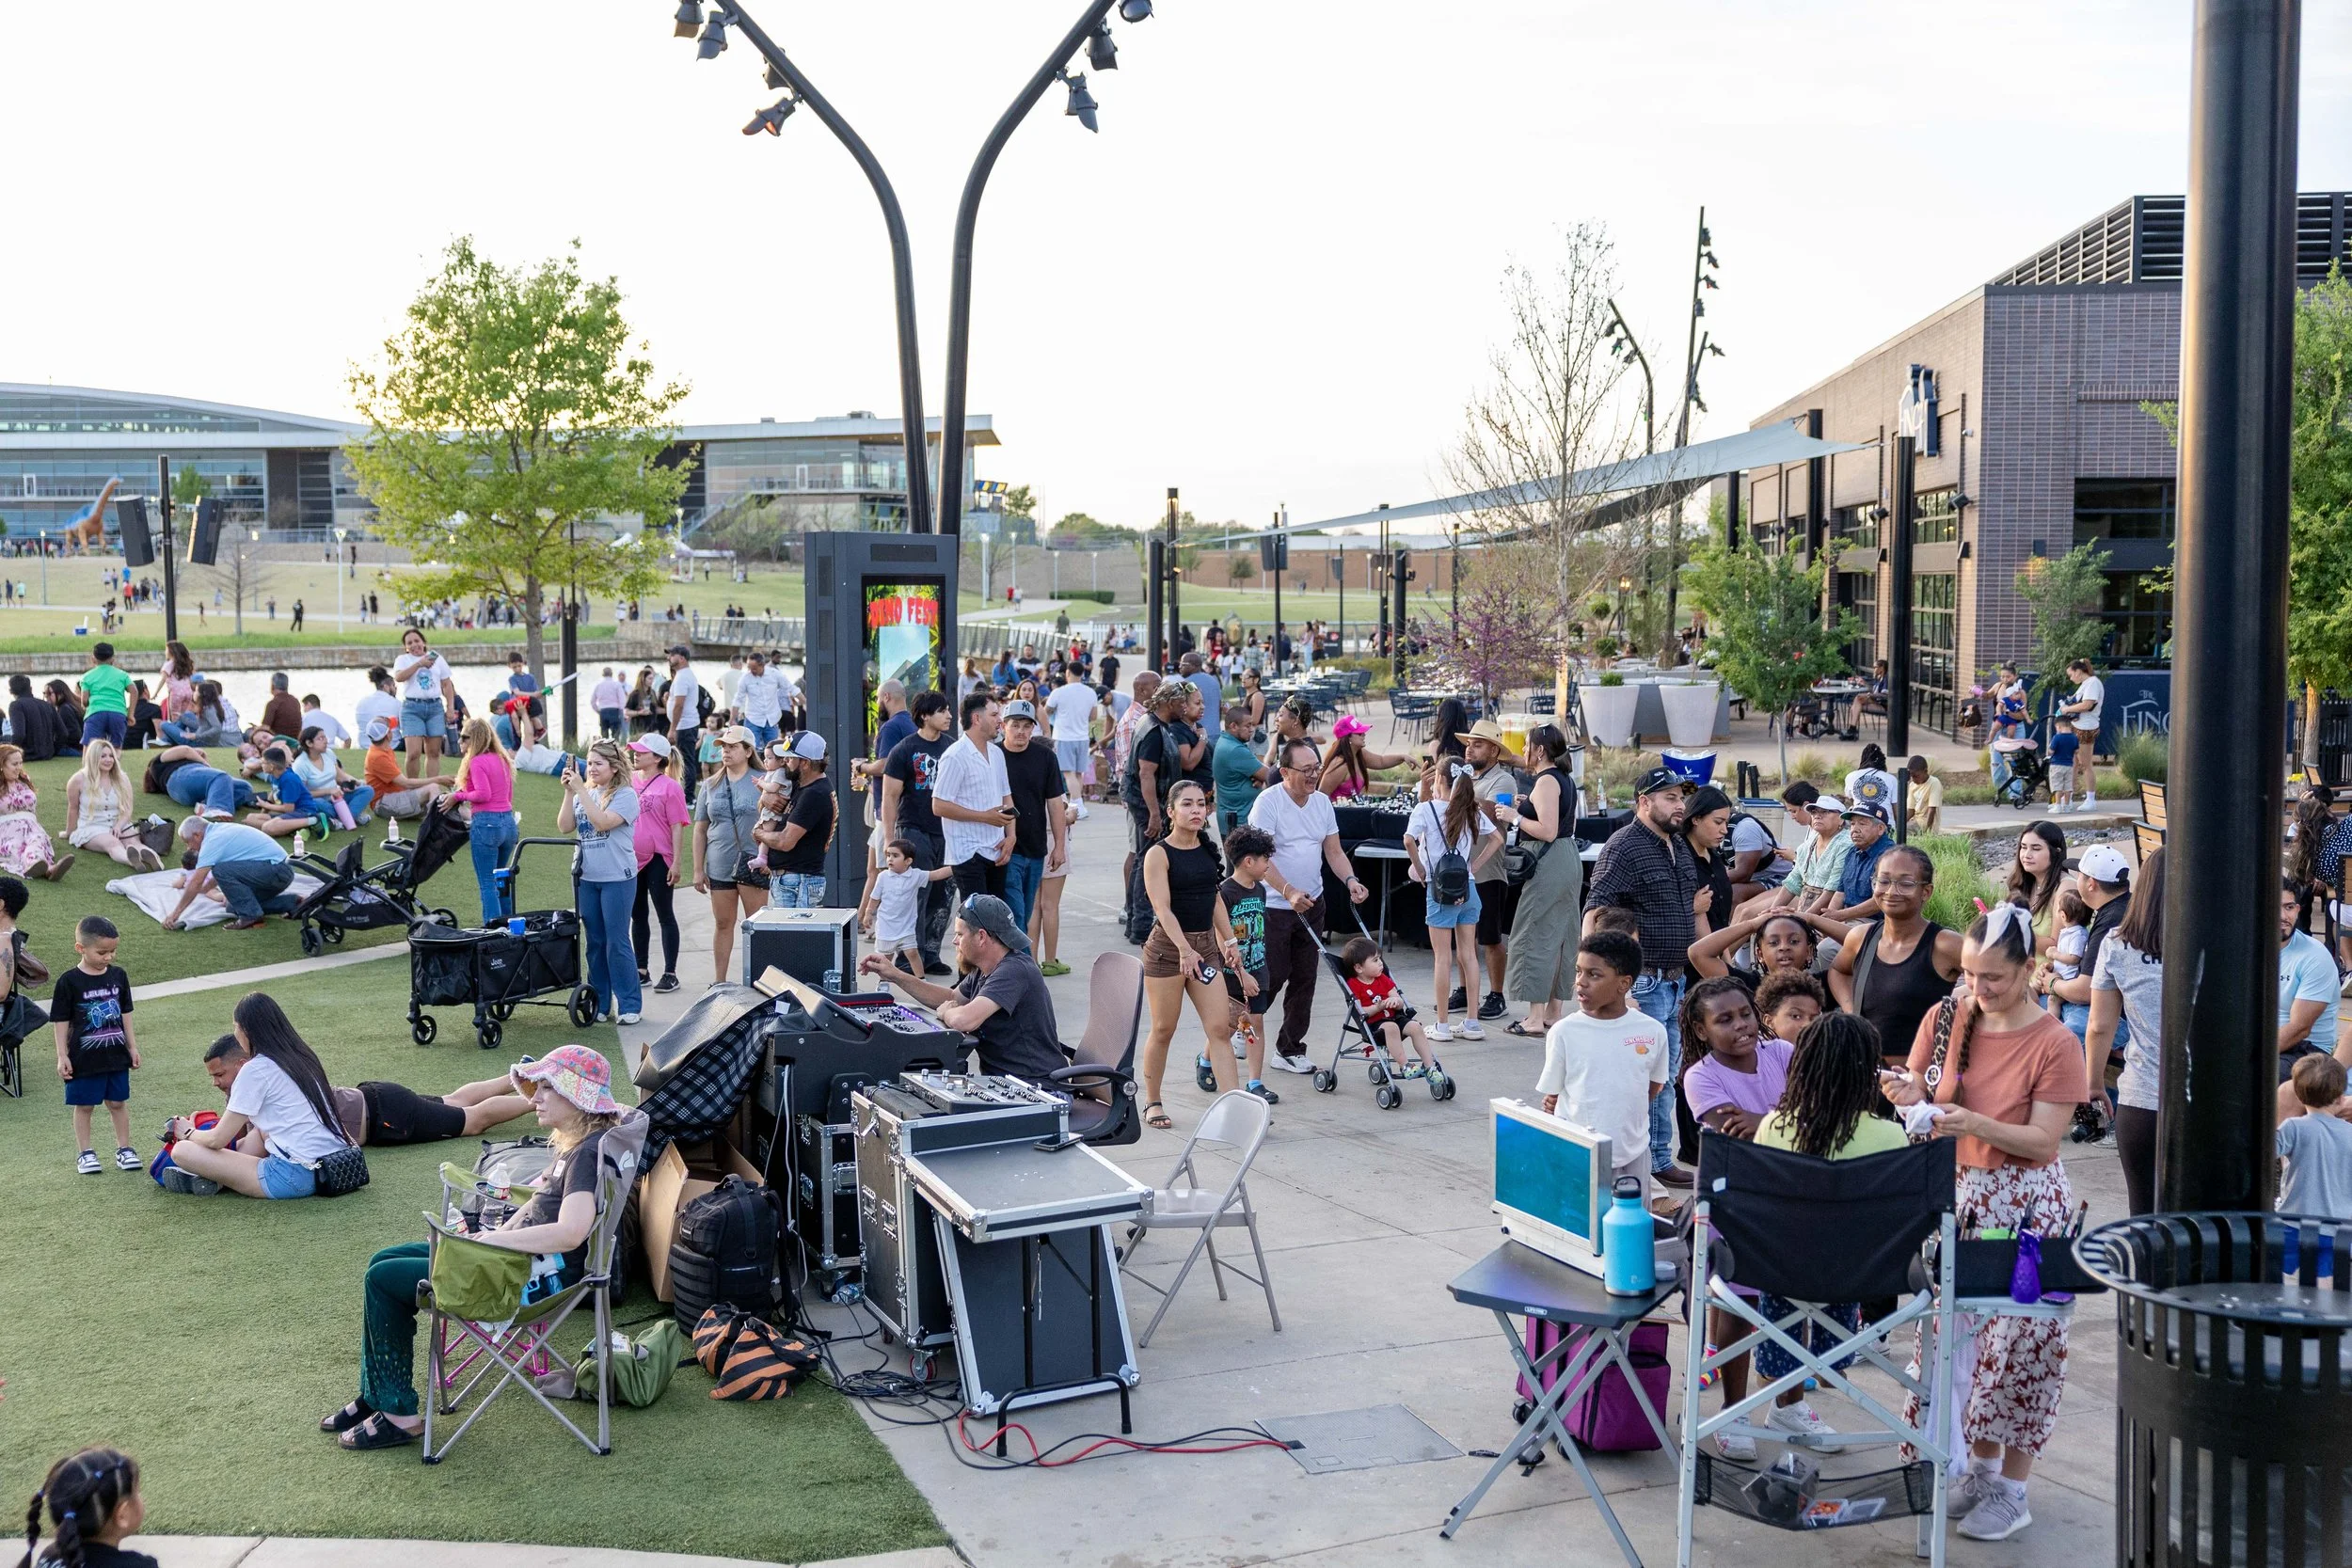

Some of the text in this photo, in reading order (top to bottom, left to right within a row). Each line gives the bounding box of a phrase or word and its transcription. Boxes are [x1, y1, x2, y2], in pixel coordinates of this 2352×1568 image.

[869, 595, 939, 628] DINO FEST
[83, 989, 111, 1000] LEVEL
